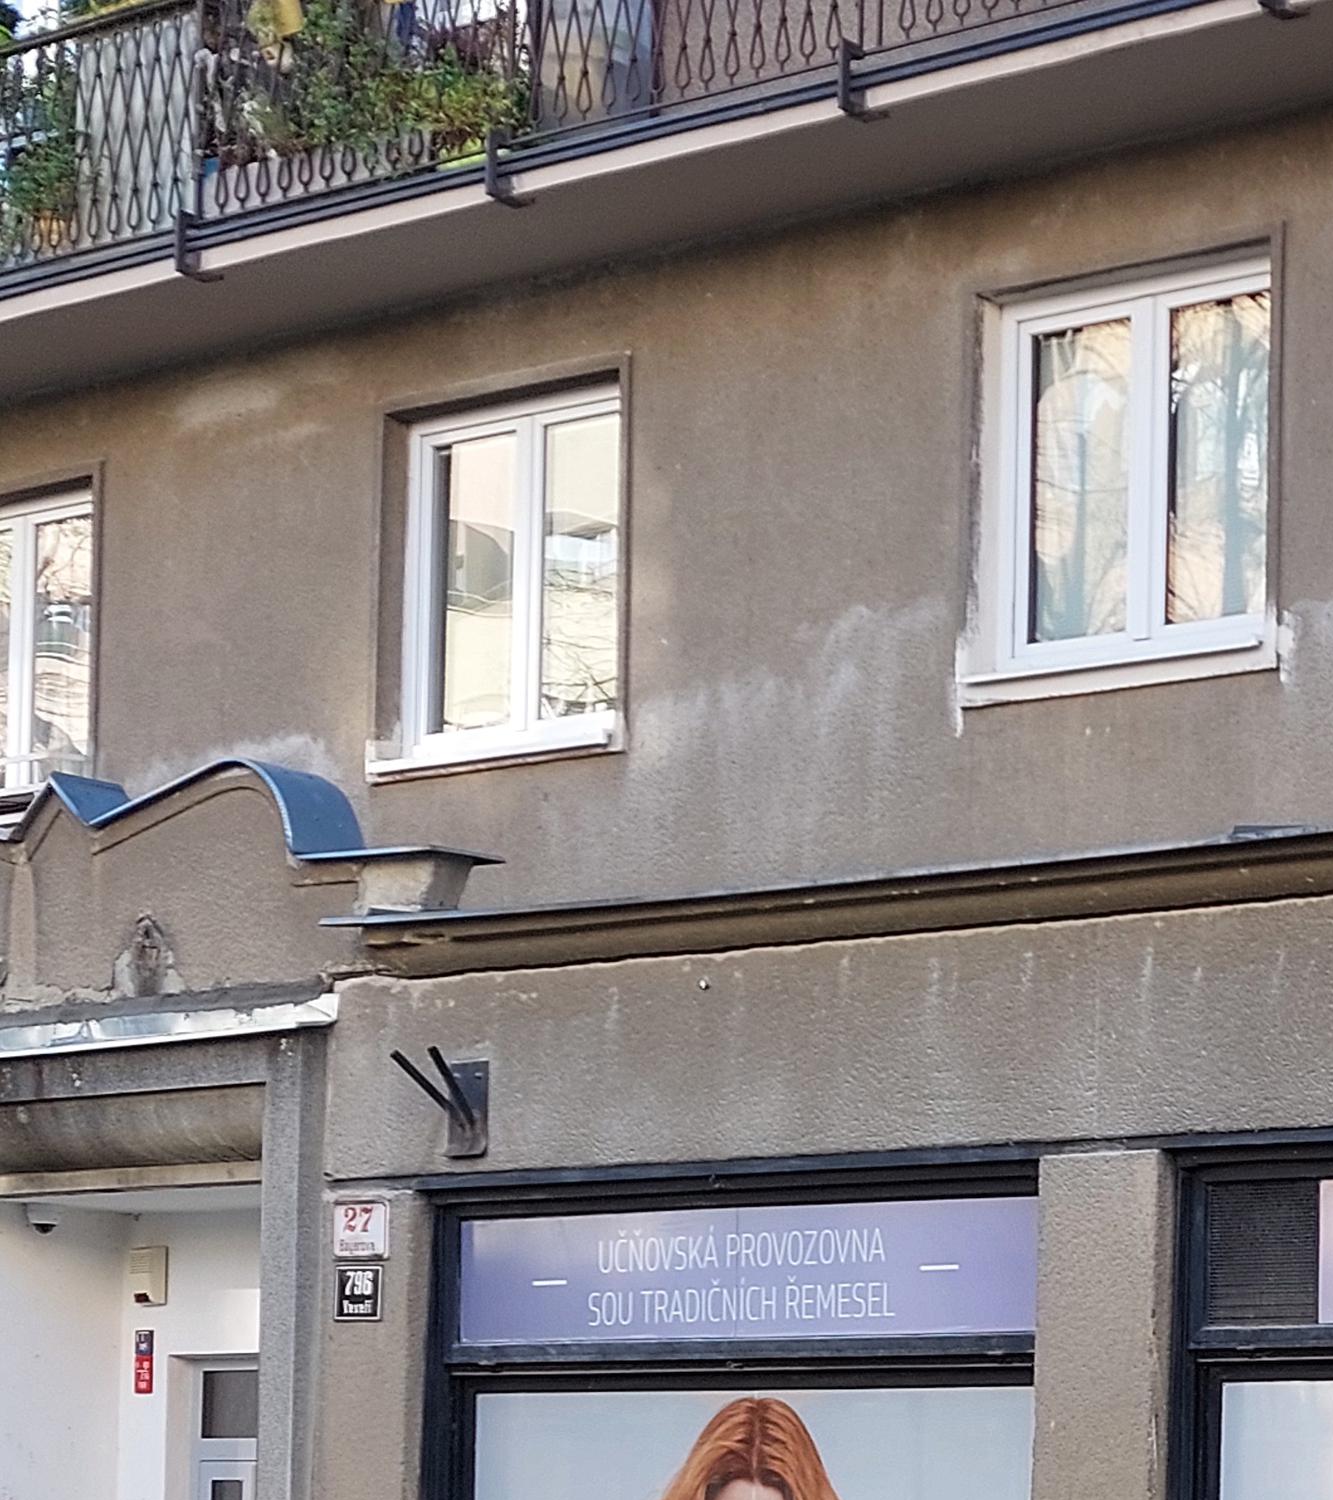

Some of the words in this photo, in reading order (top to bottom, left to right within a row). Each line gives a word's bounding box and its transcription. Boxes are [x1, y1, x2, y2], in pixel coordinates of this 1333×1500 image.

[342, 1205, 374, 1233] 27
[598, 1224, 719, 1274] UČŇOVSKÁ
[725, 1227, 887, 1268] PROVOZOVNA
[344, 1270, 374, 1296] 796
[587, 1290, 634, 1327] SOU
[639, 1277, 778, 1324] TRADIČNÍCH
[784, 1274, 897, 1320] ŘEMESEL
